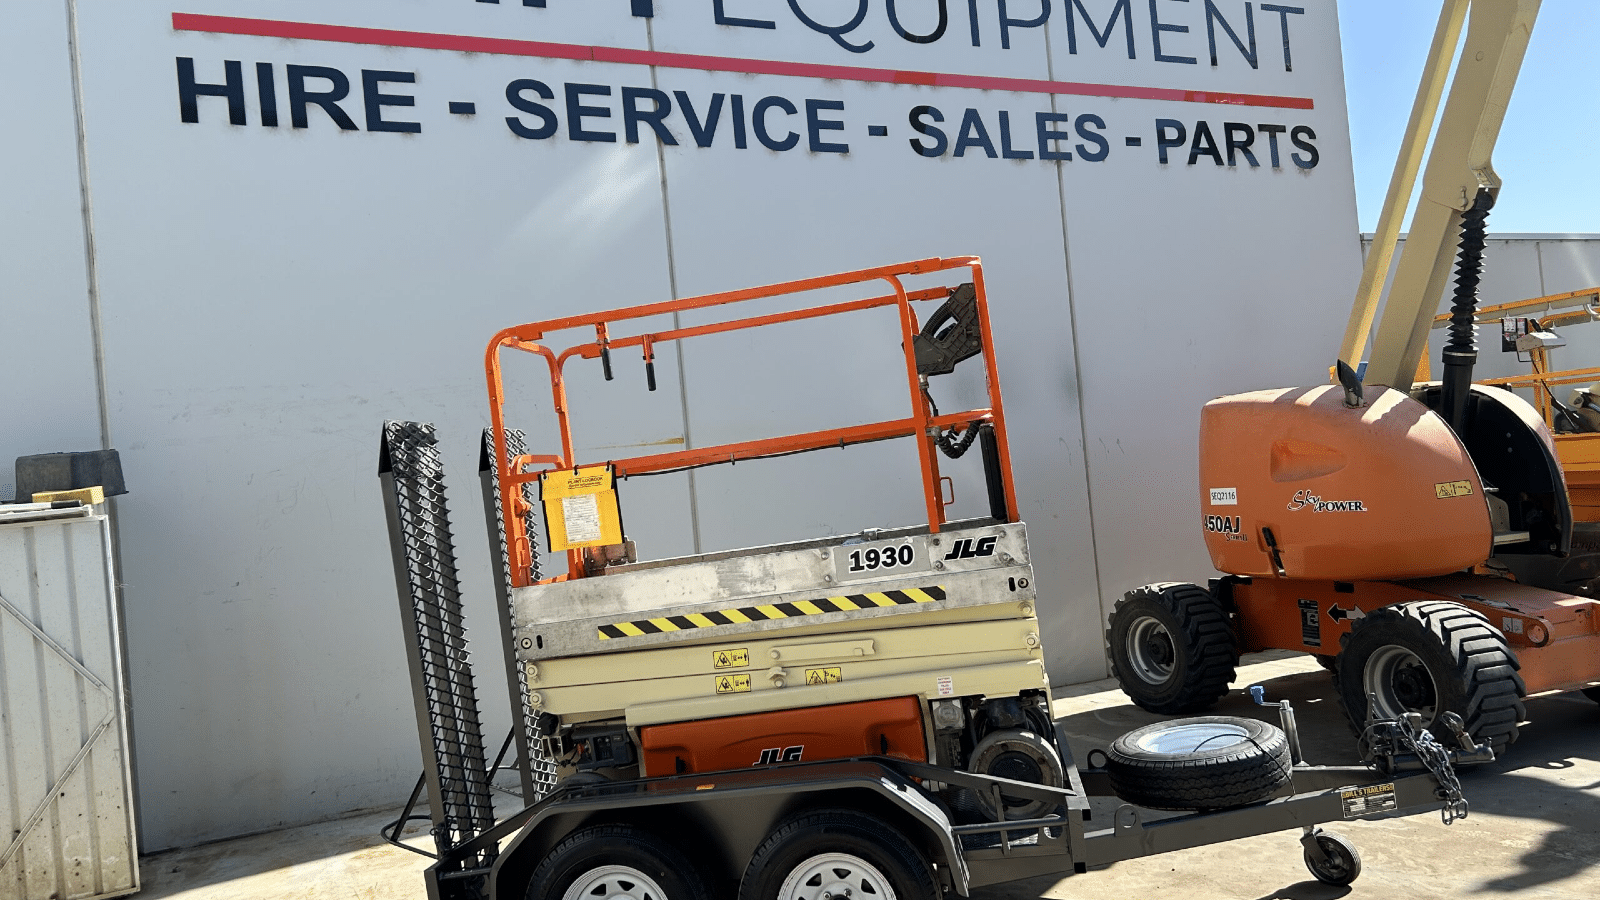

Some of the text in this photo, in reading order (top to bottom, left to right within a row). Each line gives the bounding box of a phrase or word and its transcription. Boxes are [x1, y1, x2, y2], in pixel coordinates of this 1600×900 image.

[176, 57, 422, 133] HIRE
[505, 78, 849, 153] SERVICE
[908, 105, 1109, 162] SALES
[1158, 119, 1320, 170] PARTS
[1211, 491, 1236, 501] SEQ2116
[1204, 514, 1241, 534] 450AJ
[848, 534, 999, 574] 1930 JLG
[752, 745, 804, 766] JLG
